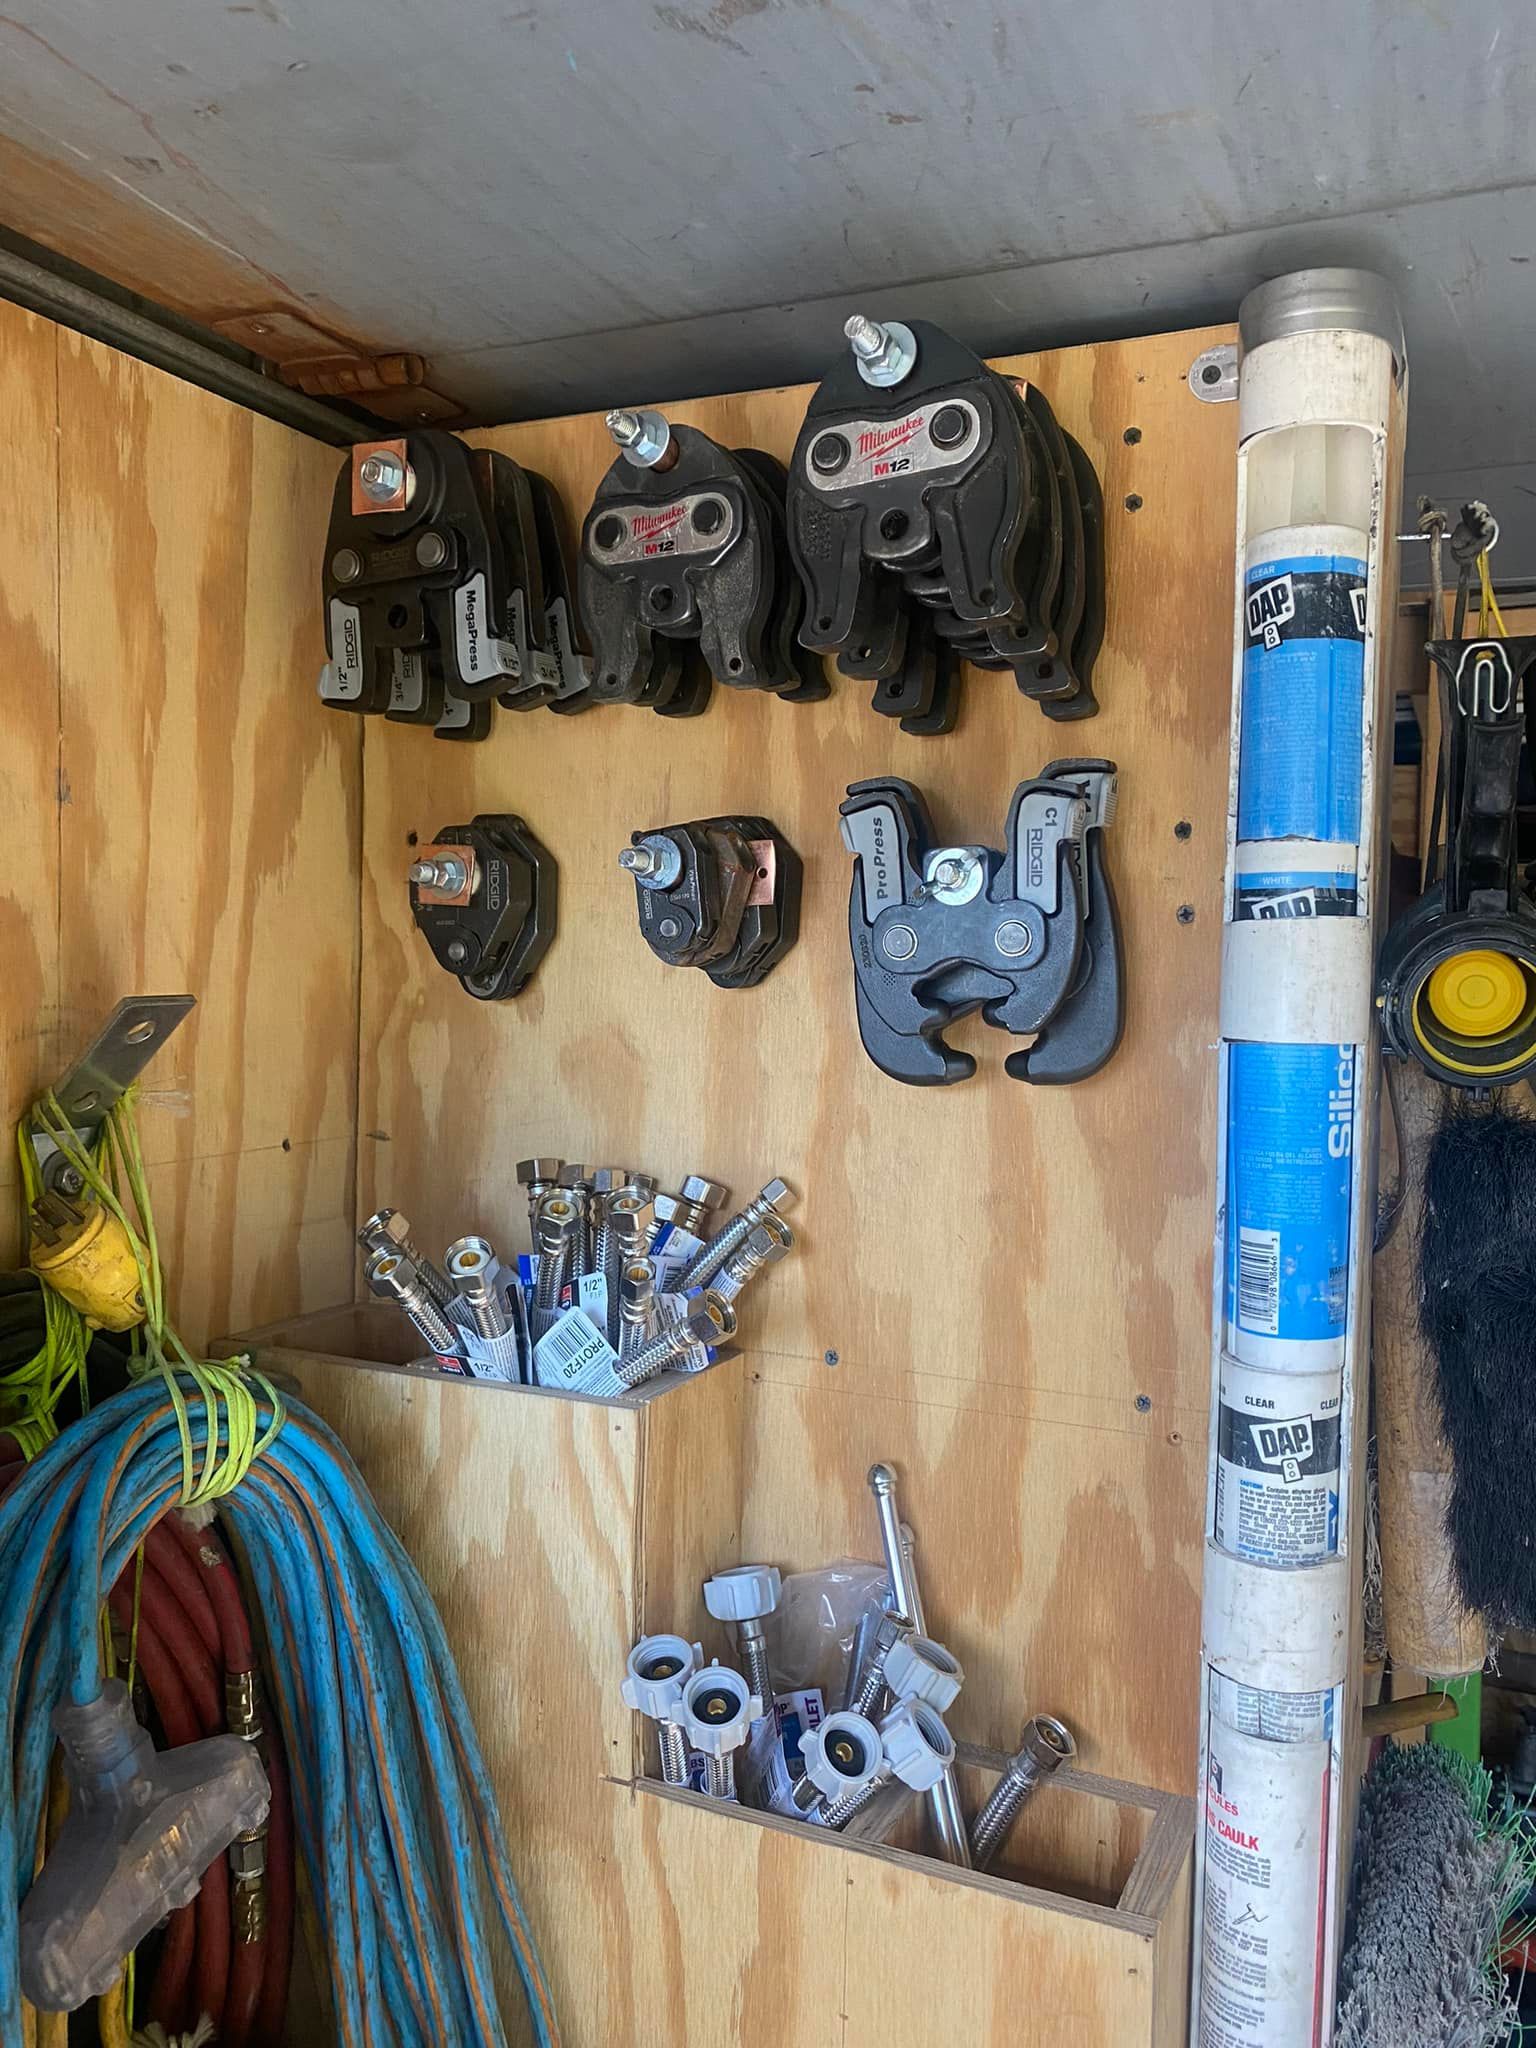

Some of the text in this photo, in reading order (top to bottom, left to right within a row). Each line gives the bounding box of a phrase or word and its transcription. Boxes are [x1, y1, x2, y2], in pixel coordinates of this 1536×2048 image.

[856, 414, 926, 452] Milwaukee
[873, 458, 911, 477] M12
[631, 504, 687, 535] Milwaukee
[644, 539, 675, 554] M12
[1251, 565, 1275, 579] CLEAR
[346, 618, 356, 668] RIDGID
[466, 589, 478, 671] MegaPress
[339, 666, 349, 692] 1/2"
[1045, 807, 1057, 827] C1
[872, 817, 885, 900] ProPress
[1030, 828, 1043, 888] RIDGID
[488, 860, 500, 911] RIDGID
[1263, 876, 1291, 885] WHITE
[583, 1278, 602, 1292] 1/2"
[474, 1362, 494, 1373] 1/2"
[563, 1337, 604, 1379] PRO1F20
[1245, 1395, 1275, 1409] CLEAR
[1218, 1820, 1260, 1851] CAULK
